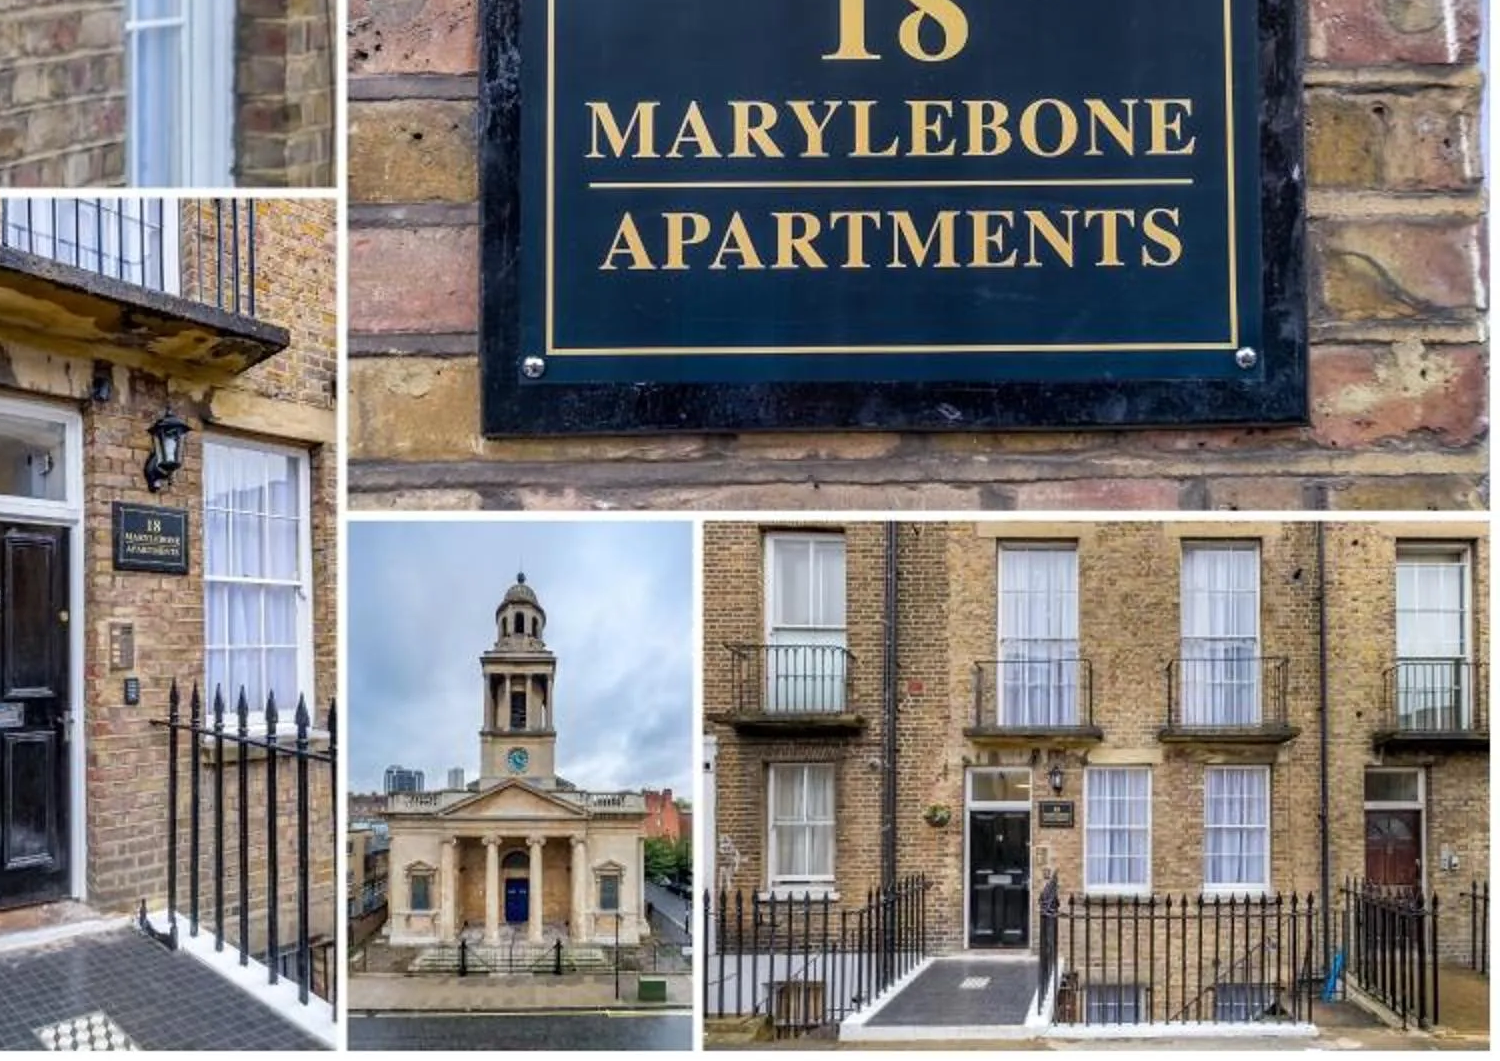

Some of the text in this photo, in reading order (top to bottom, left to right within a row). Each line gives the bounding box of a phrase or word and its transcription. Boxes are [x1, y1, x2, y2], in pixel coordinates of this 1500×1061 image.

[584, 98, 1197, 160] MARYLEBONE
[598, 207, 1183, 271] APARTMENTS
[147, 519, 161, 532] 18
